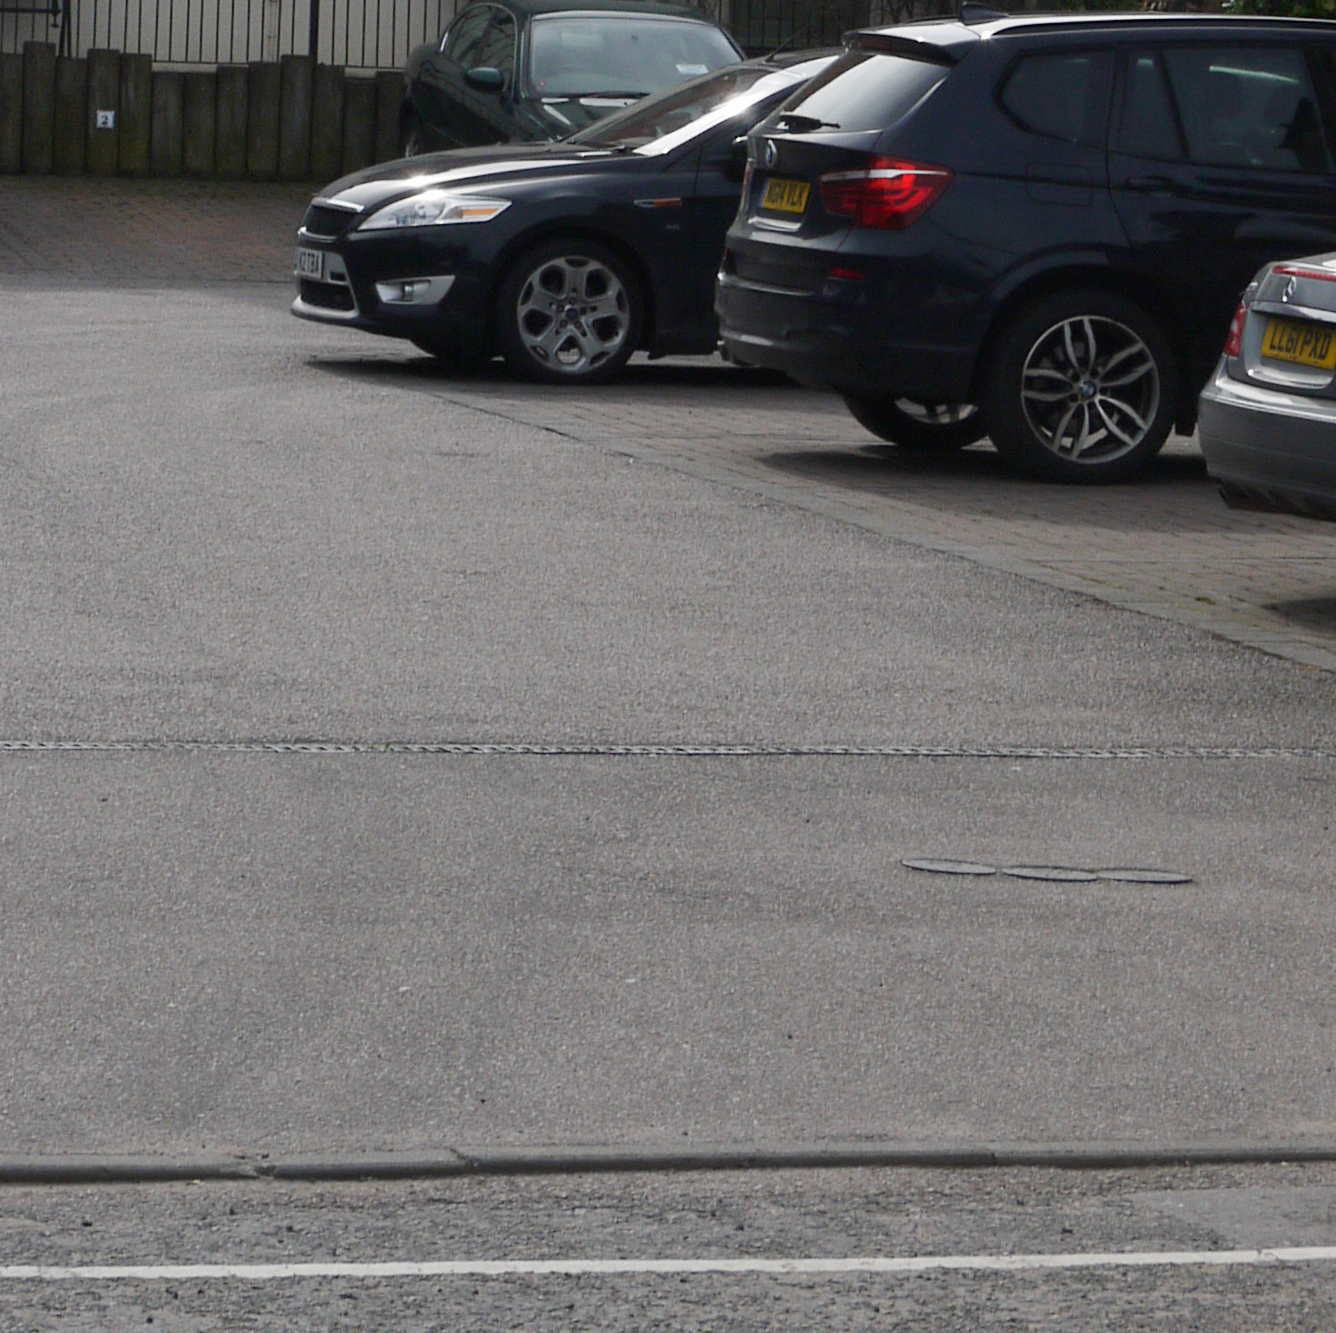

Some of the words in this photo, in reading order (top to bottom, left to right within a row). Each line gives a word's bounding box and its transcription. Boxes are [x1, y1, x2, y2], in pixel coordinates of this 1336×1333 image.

[100, 114, 109, 126] 2
[1268, 320, 1302, 355] LL61
[1298, 329, 1333, 360] PXD
